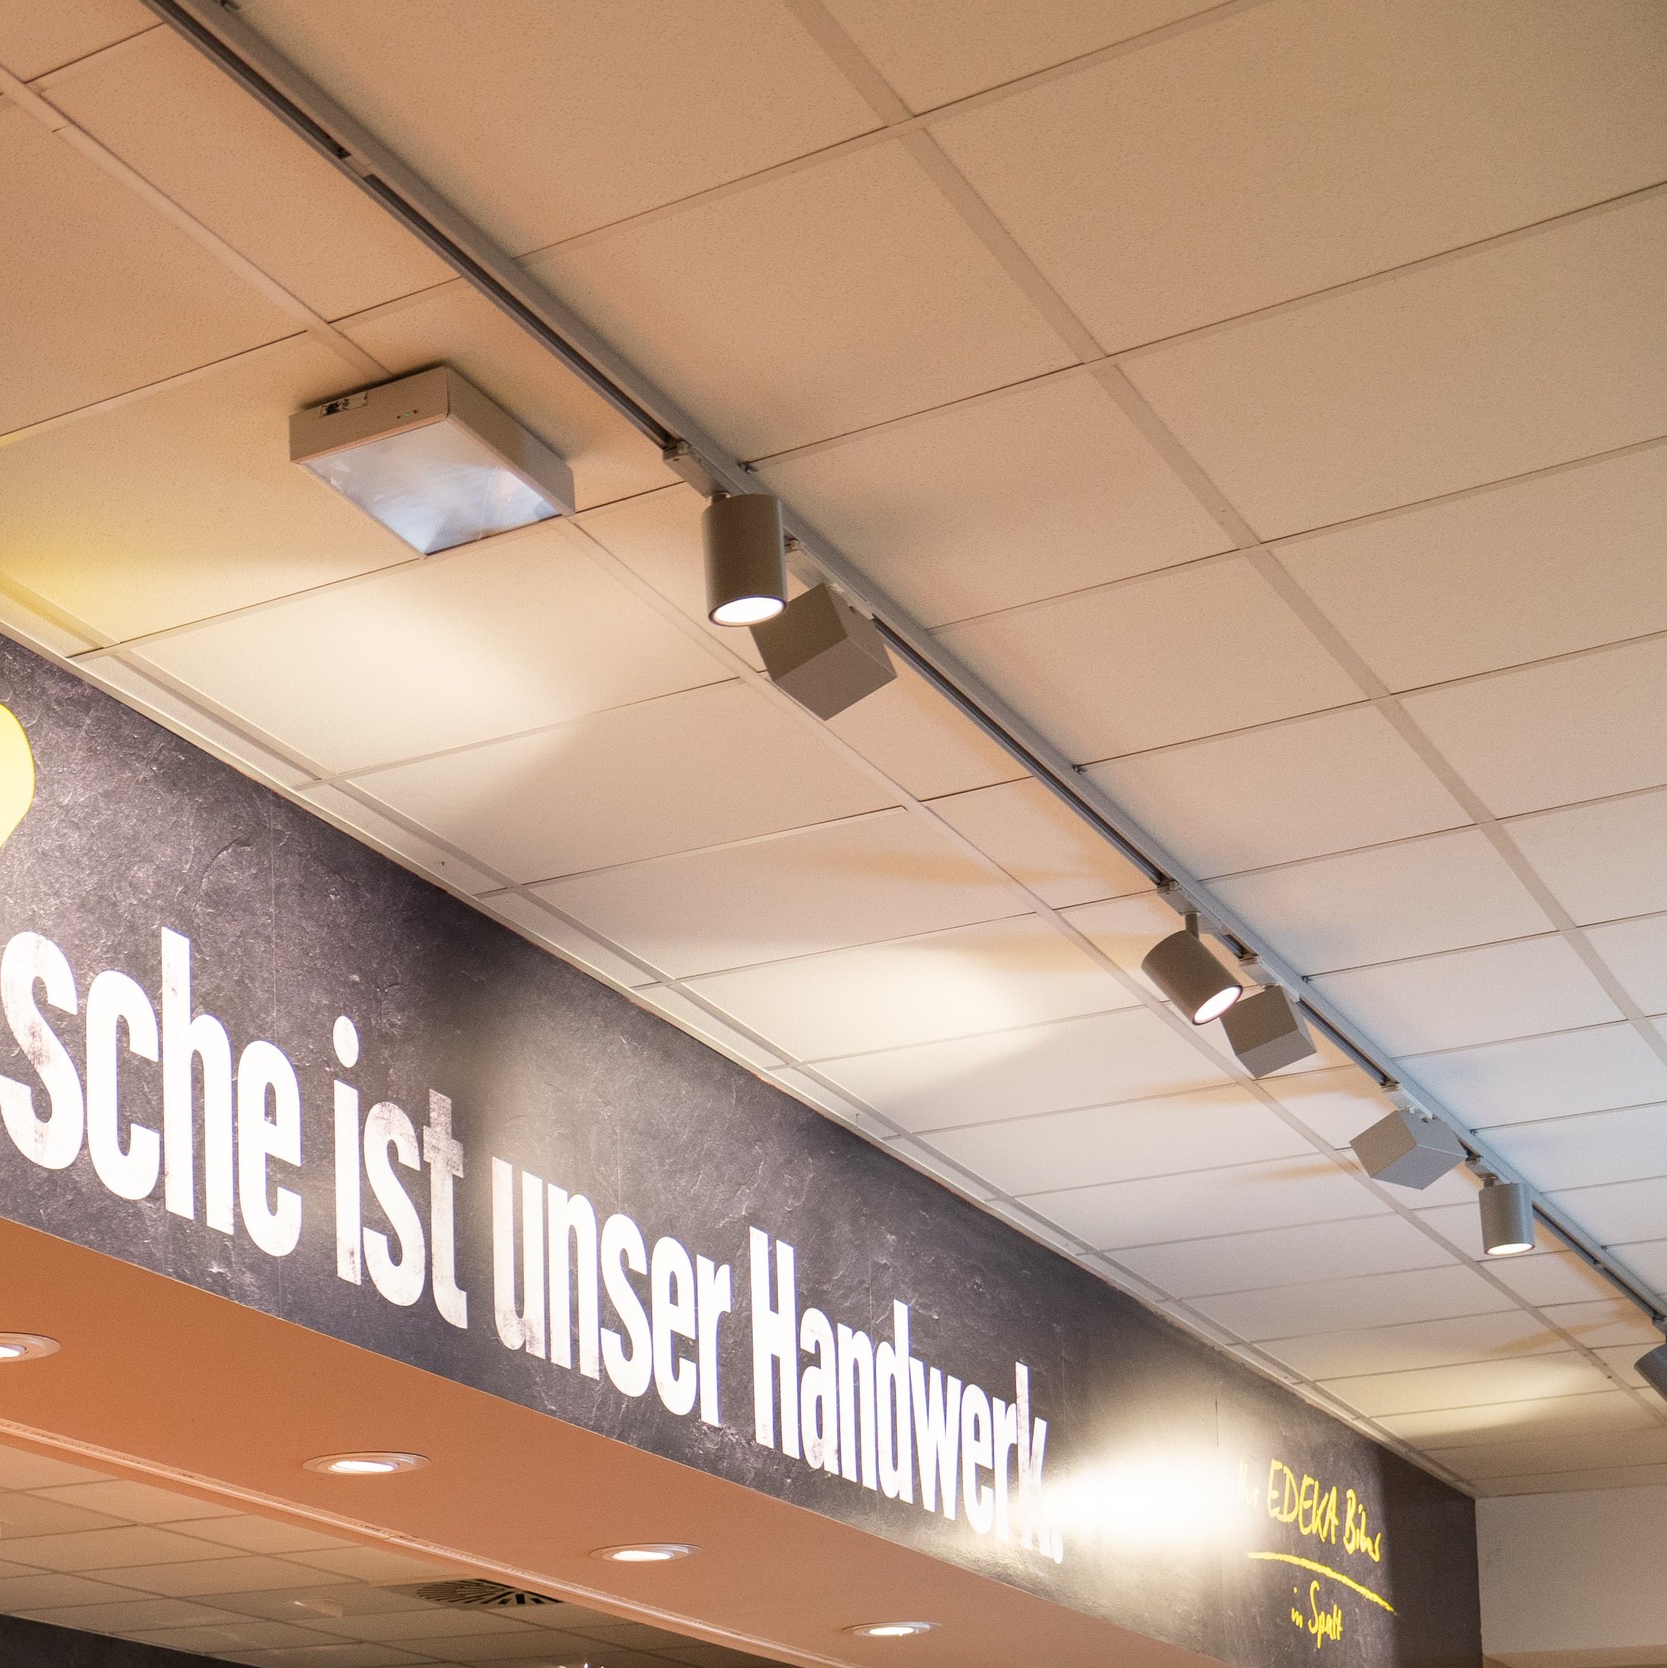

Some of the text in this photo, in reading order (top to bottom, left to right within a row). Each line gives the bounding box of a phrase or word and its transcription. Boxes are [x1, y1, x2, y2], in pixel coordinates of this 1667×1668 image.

[333, 1015, 468, 1329] ist
[491, 1156, 732, 1428] unser
[1267, 1458, 1339, 1544] EDEKA
[1308, 1580, 1342, 1648] Spalt
